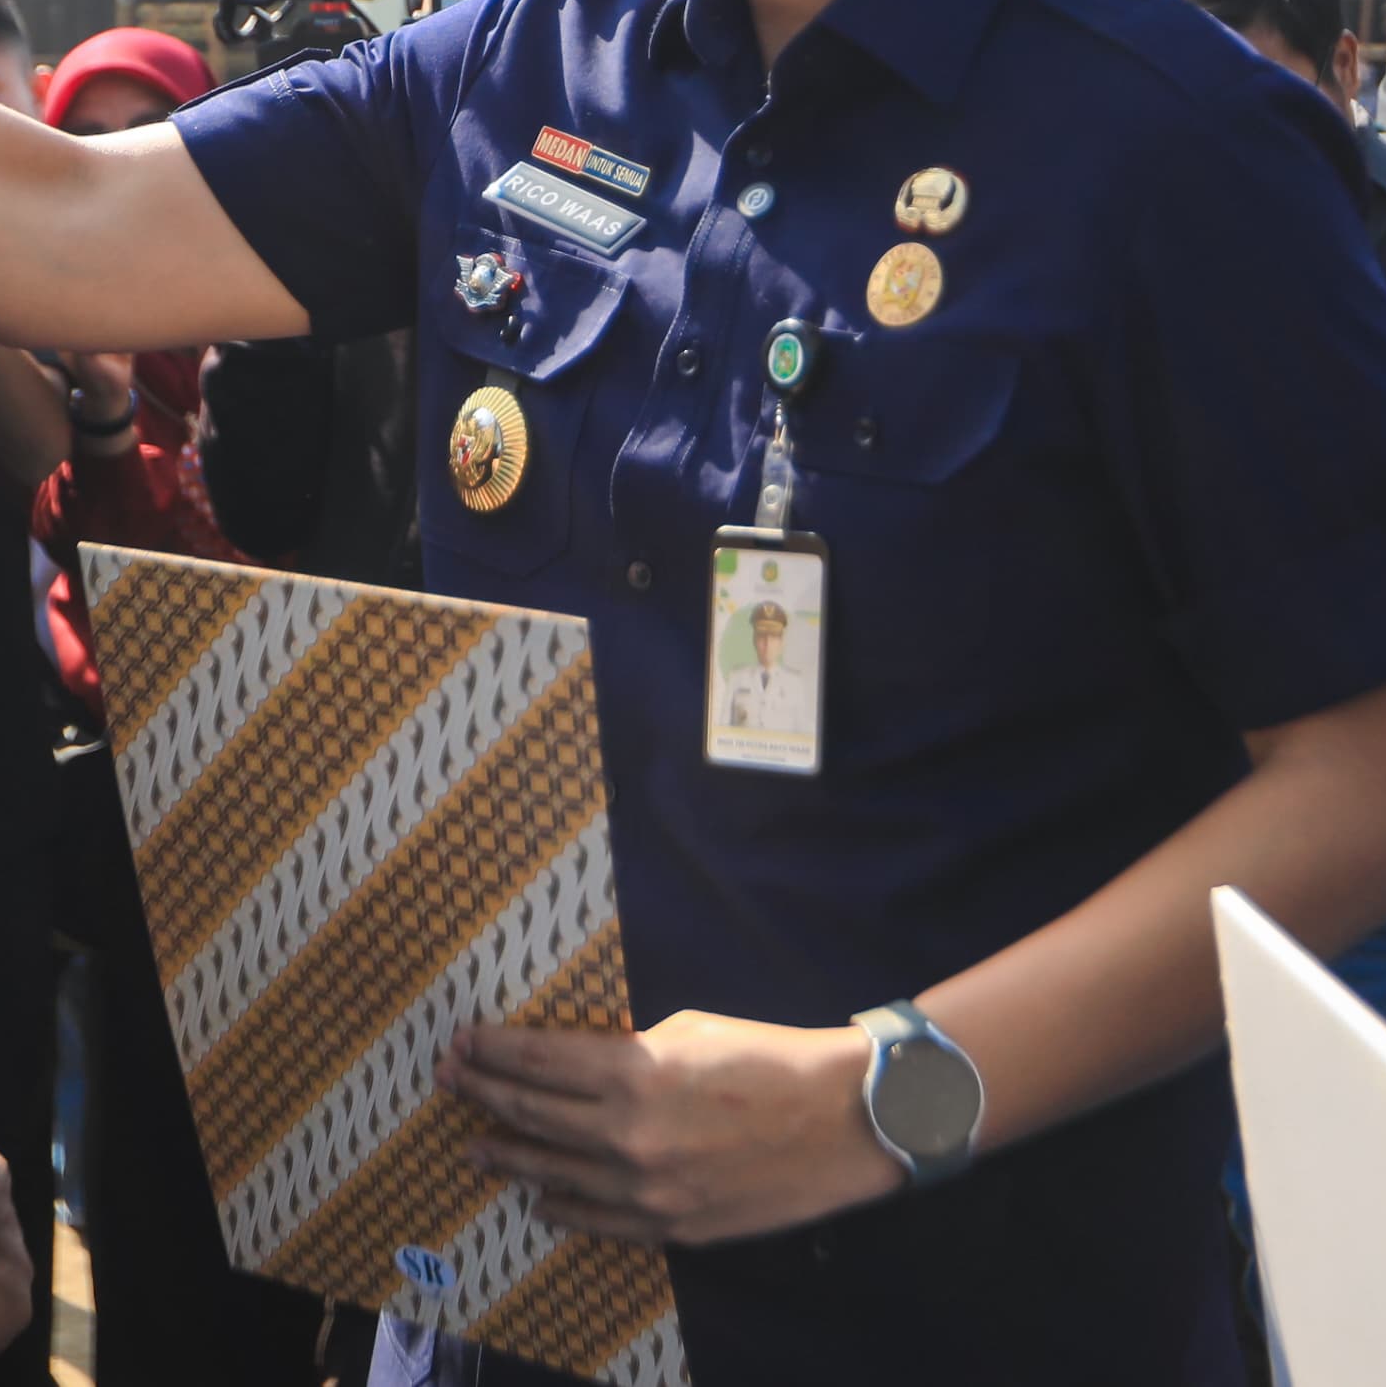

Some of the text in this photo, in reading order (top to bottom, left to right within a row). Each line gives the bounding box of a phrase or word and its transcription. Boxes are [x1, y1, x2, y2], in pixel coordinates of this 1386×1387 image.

[536, 132, 644, 189] MEDAN UNTUK SEMUA
[505, 174, 622, 236] RICO WAAS
